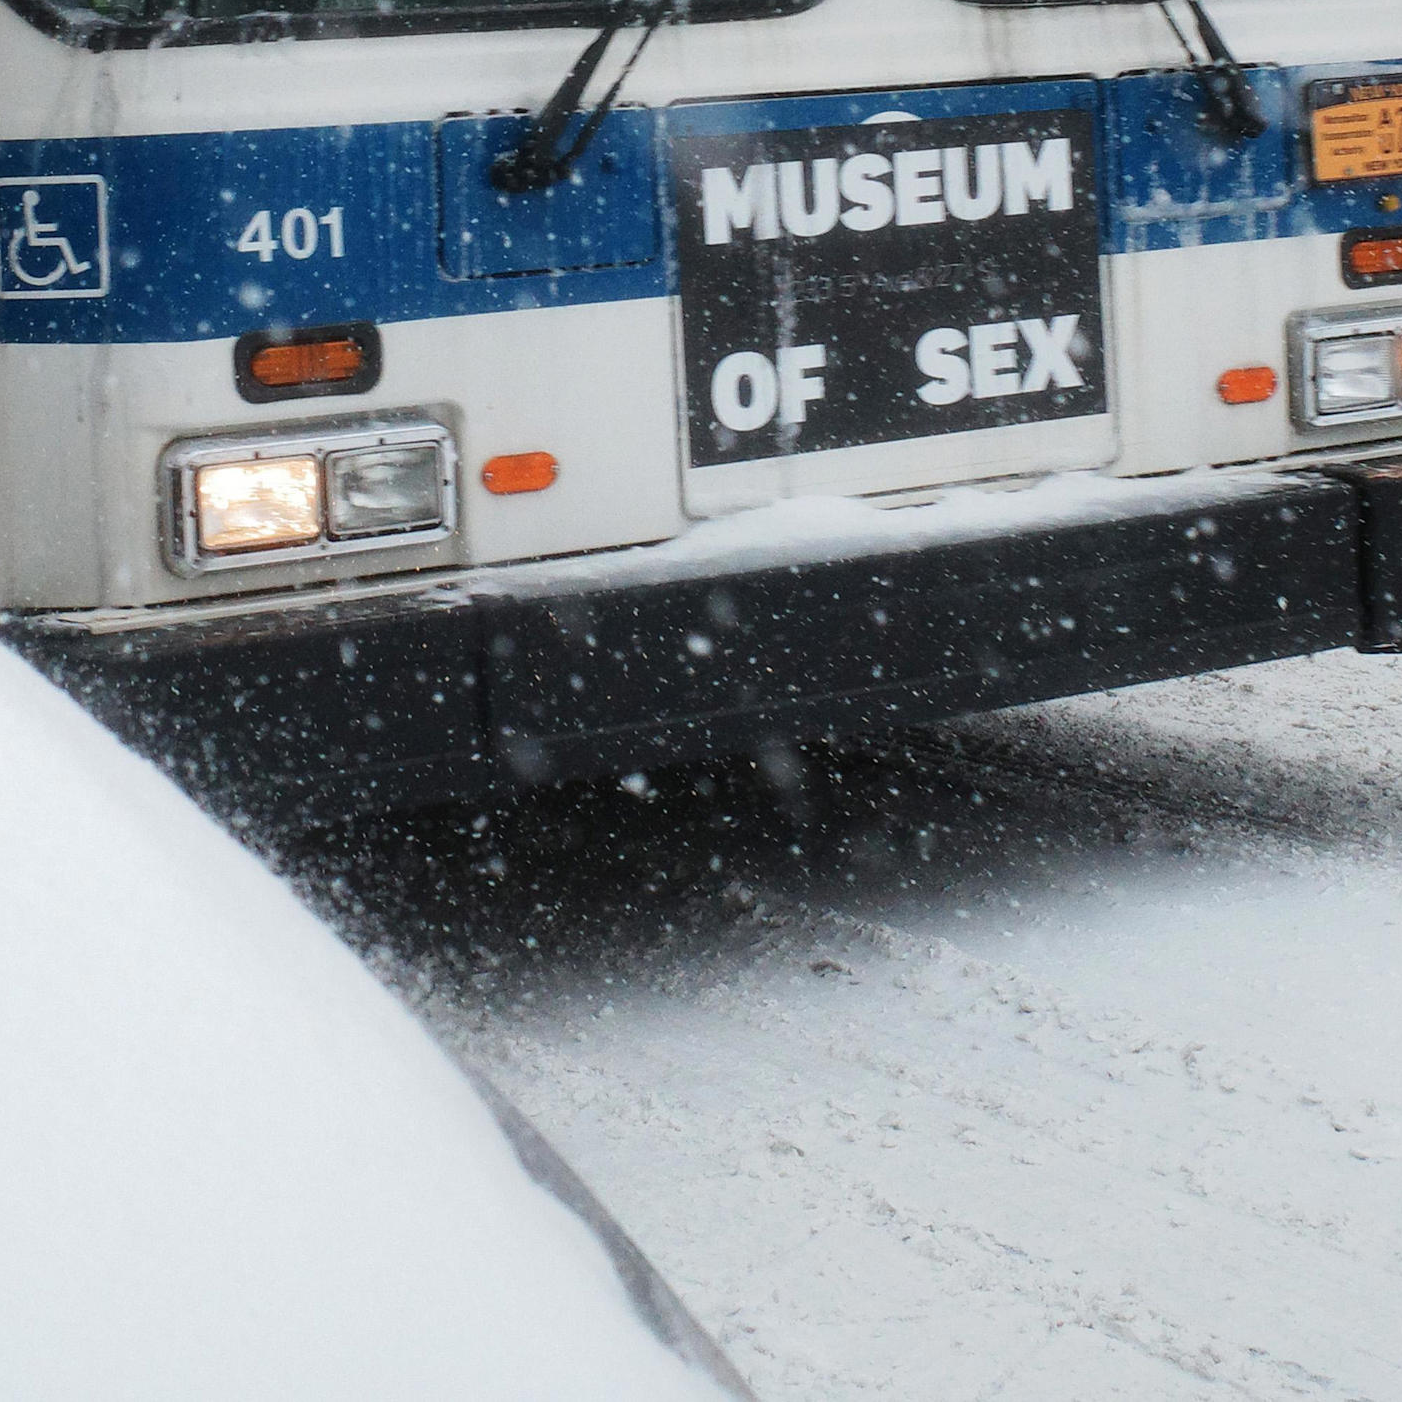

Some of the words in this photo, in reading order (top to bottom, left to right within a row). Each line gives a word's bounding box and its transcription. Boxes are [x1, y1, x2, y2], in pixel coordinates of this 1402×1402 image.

[238, 206, 346, 262] 401
[701, 138, 1074, 246] MUSEUM
[711, 344, 828, 432] OF
[915, 314, 1085, 406] SEX
